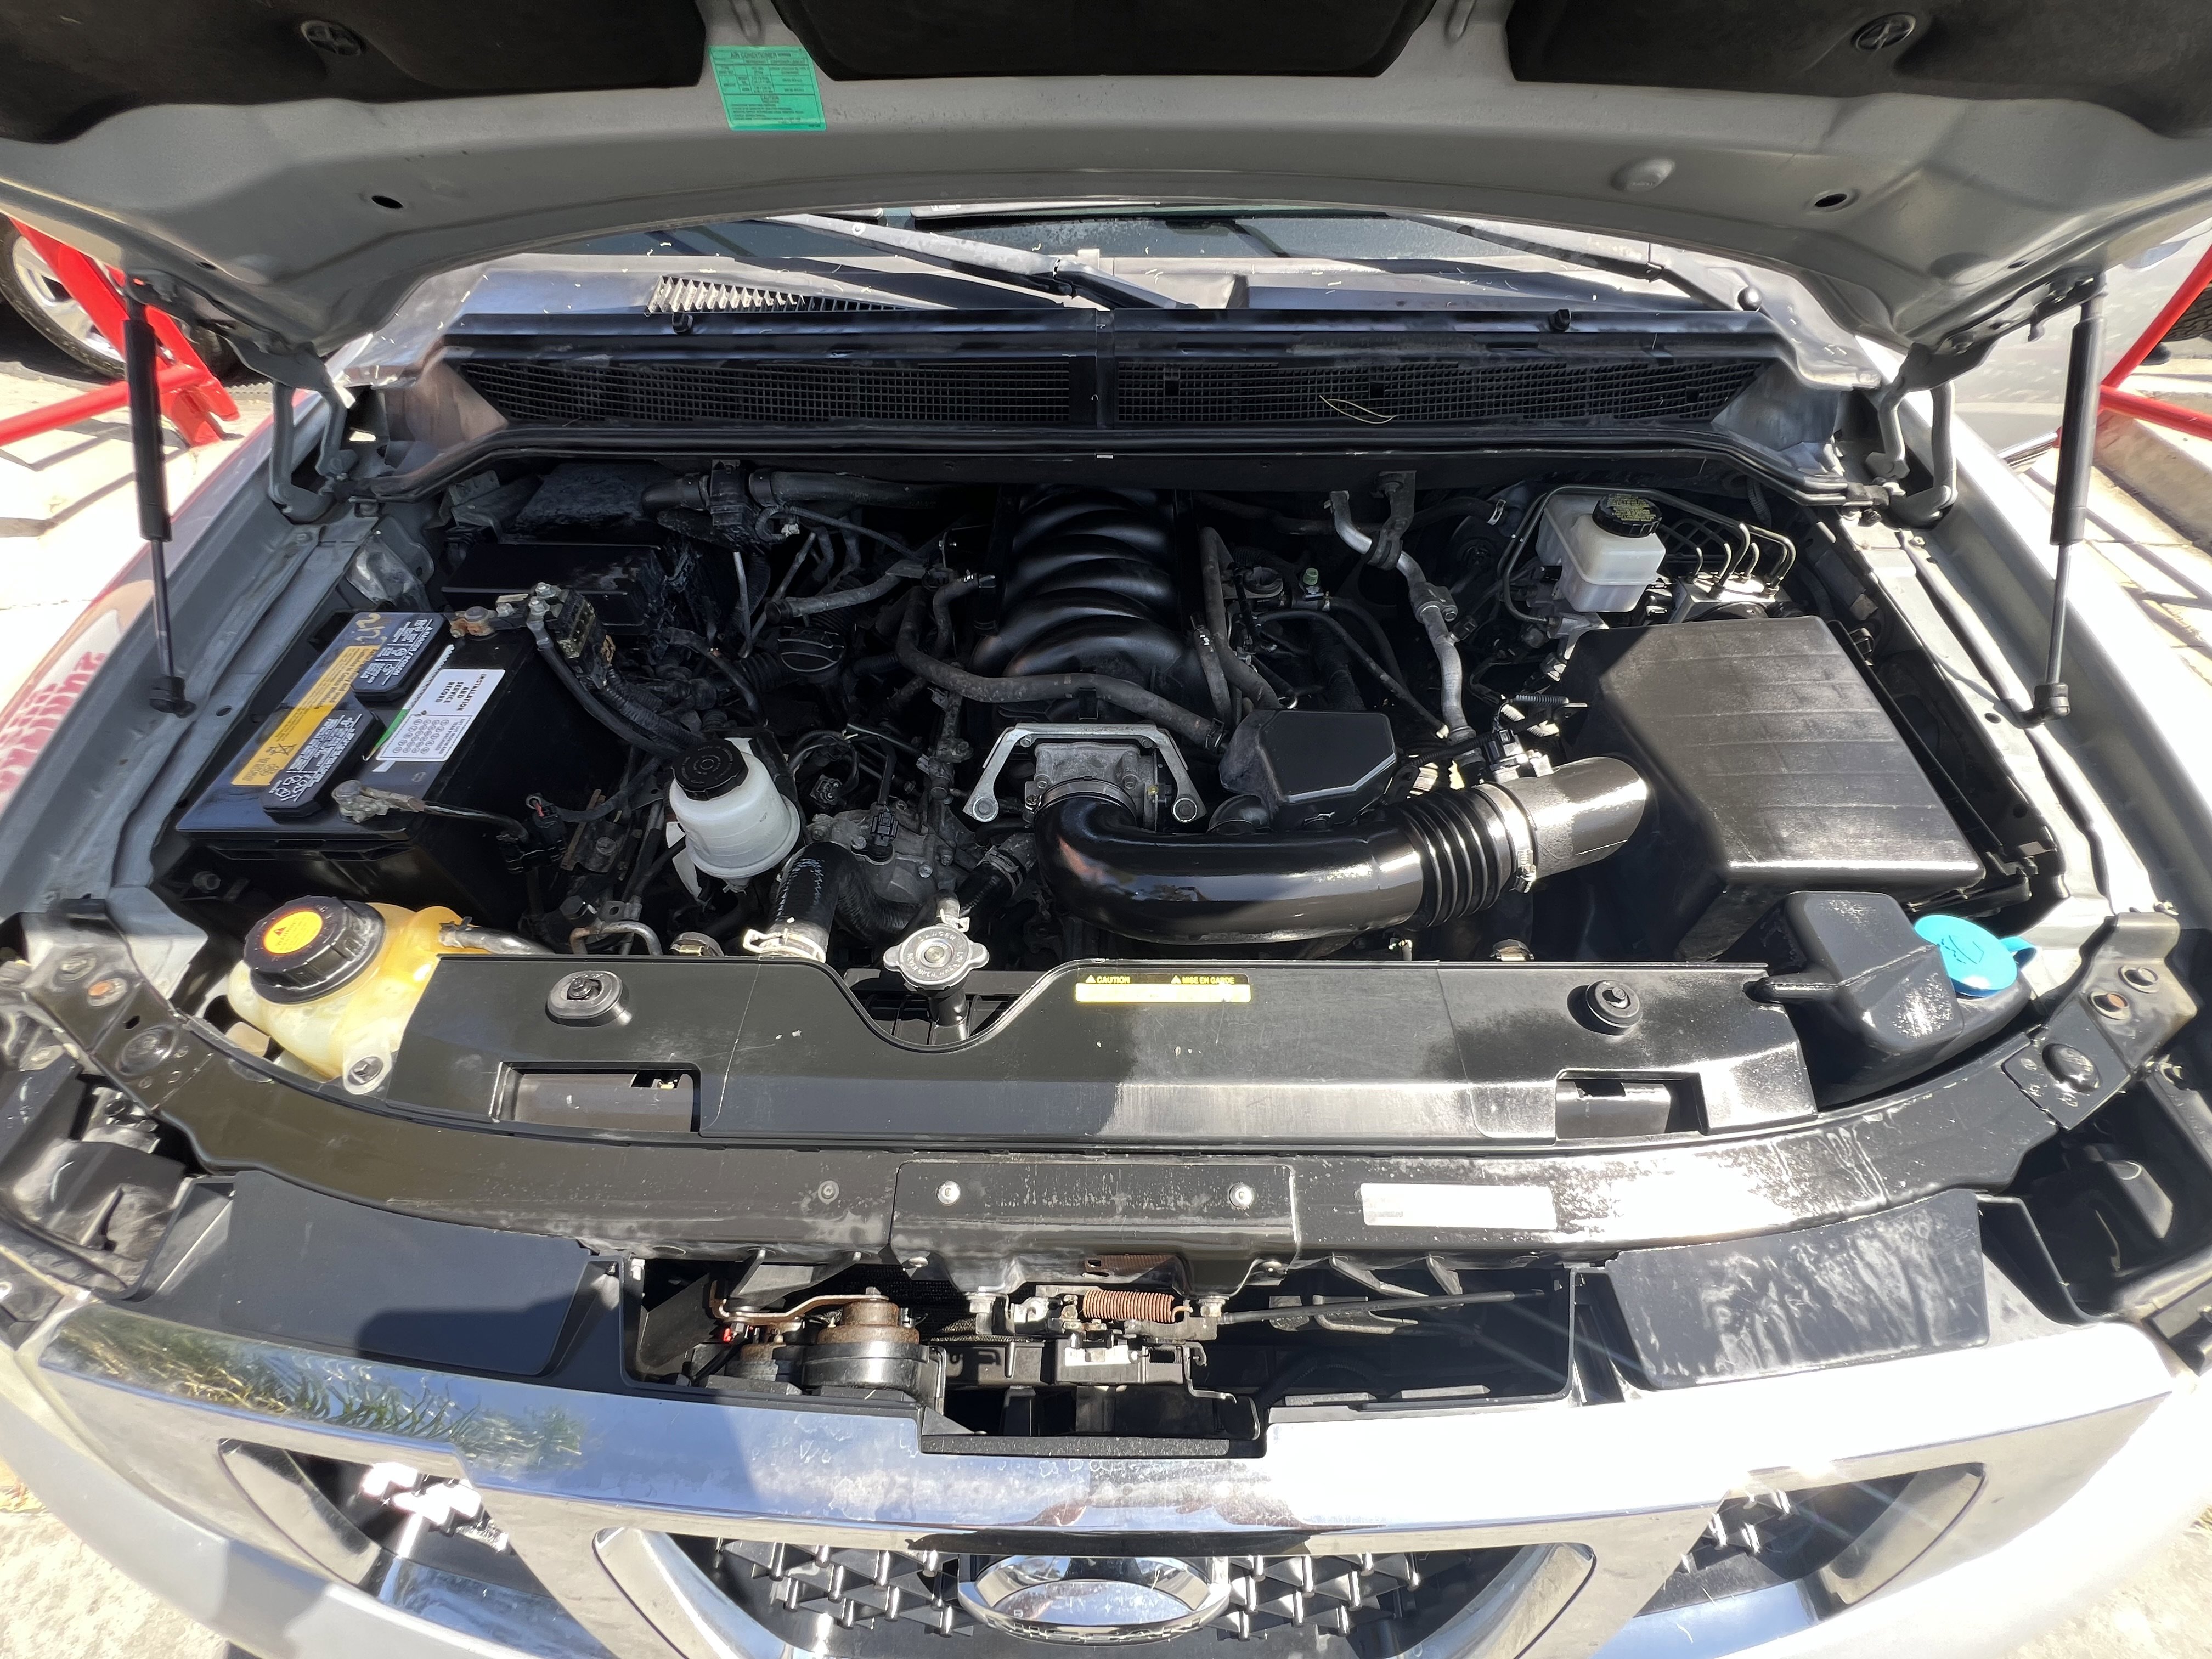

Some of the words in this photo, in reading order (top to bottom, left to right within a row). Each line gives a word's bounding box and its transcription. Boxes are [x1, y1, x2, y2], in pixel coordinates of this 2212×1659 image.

[435, 681, 455, 703] RECORD
[443, 681, 464, 703] SERVICE
[456, 686, 470, 698] AND
[456, 674, 487, 711] INSTALLATION
[1096, 975, 1131, 984] CAUTION
[1182, 975, 1198, 984] MISE
[1199, 976, 1210, 984] EN
